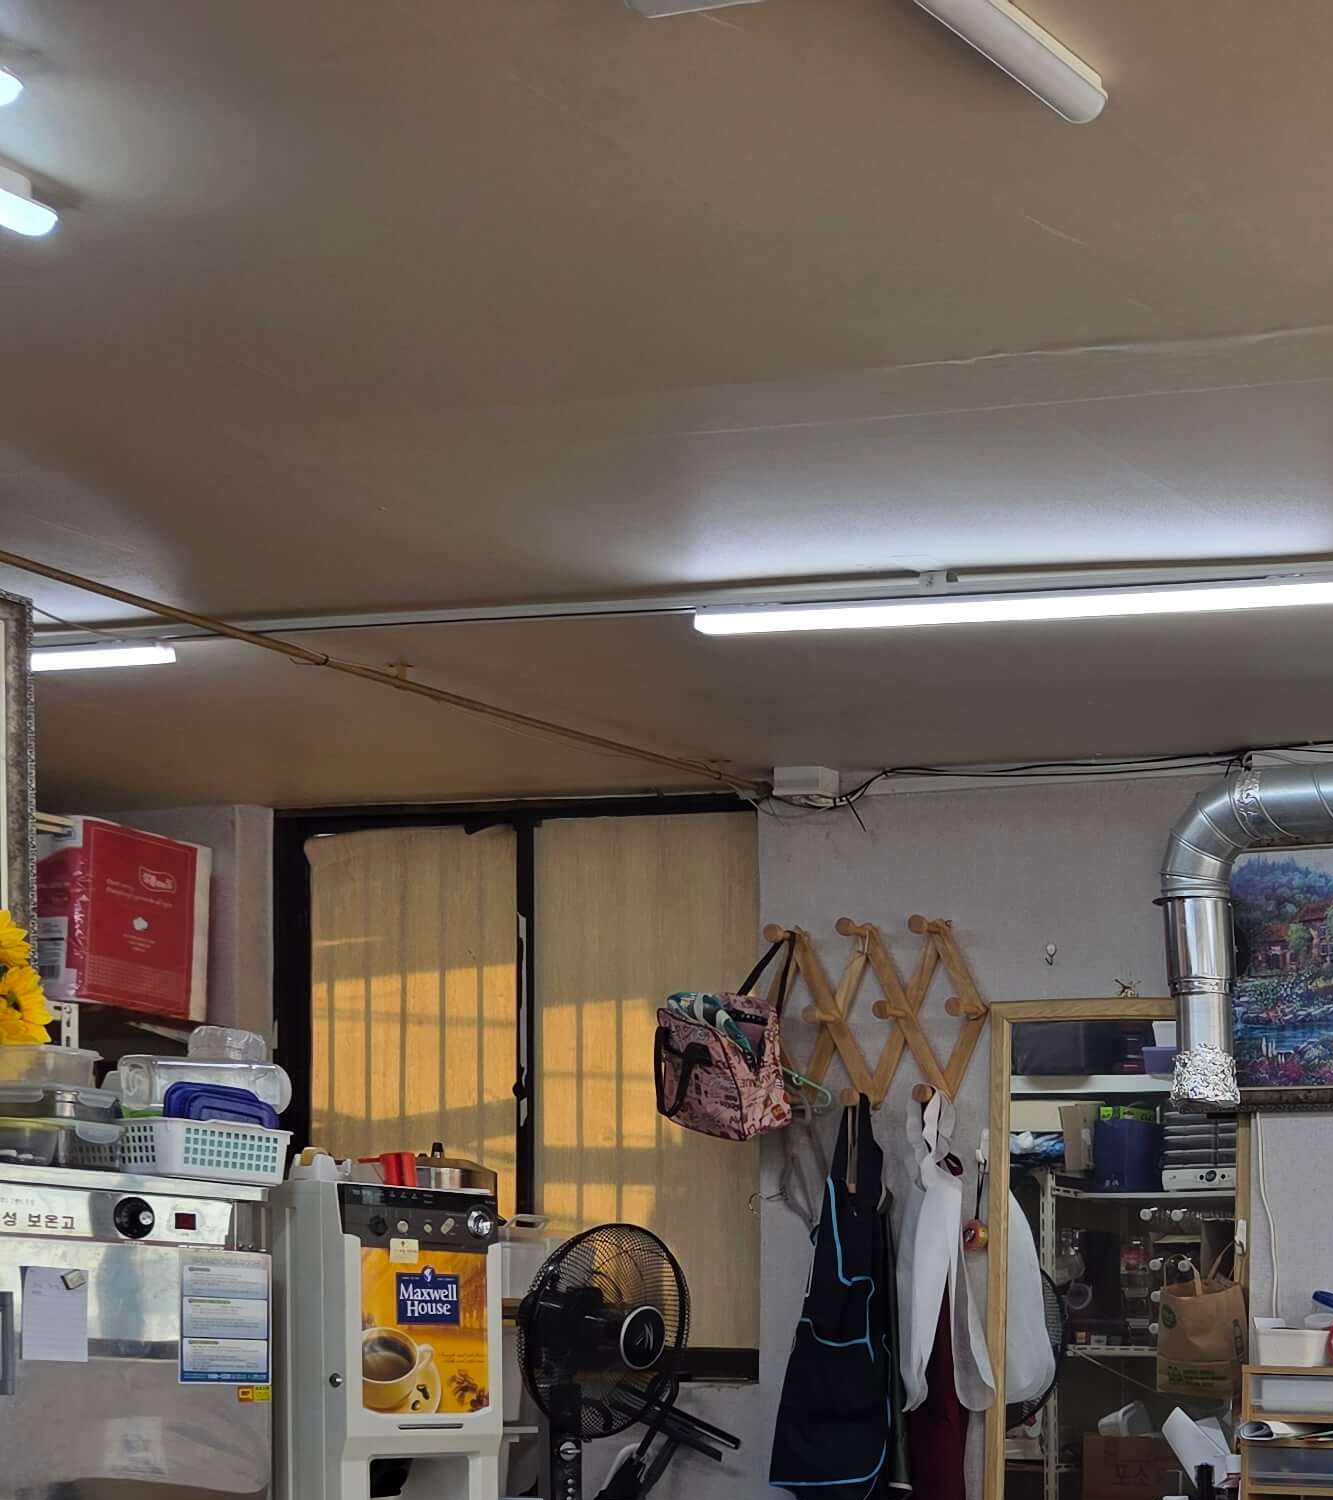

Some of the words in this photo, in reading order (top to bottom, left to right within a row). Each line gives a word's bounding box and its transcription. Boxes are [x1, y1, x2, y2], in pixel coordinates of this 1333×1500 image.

[27, 1213, 76, 1230] 보온고
[399, 1282, 457, 1300] Maxwell
[406, 1301, 451, 1316] House
